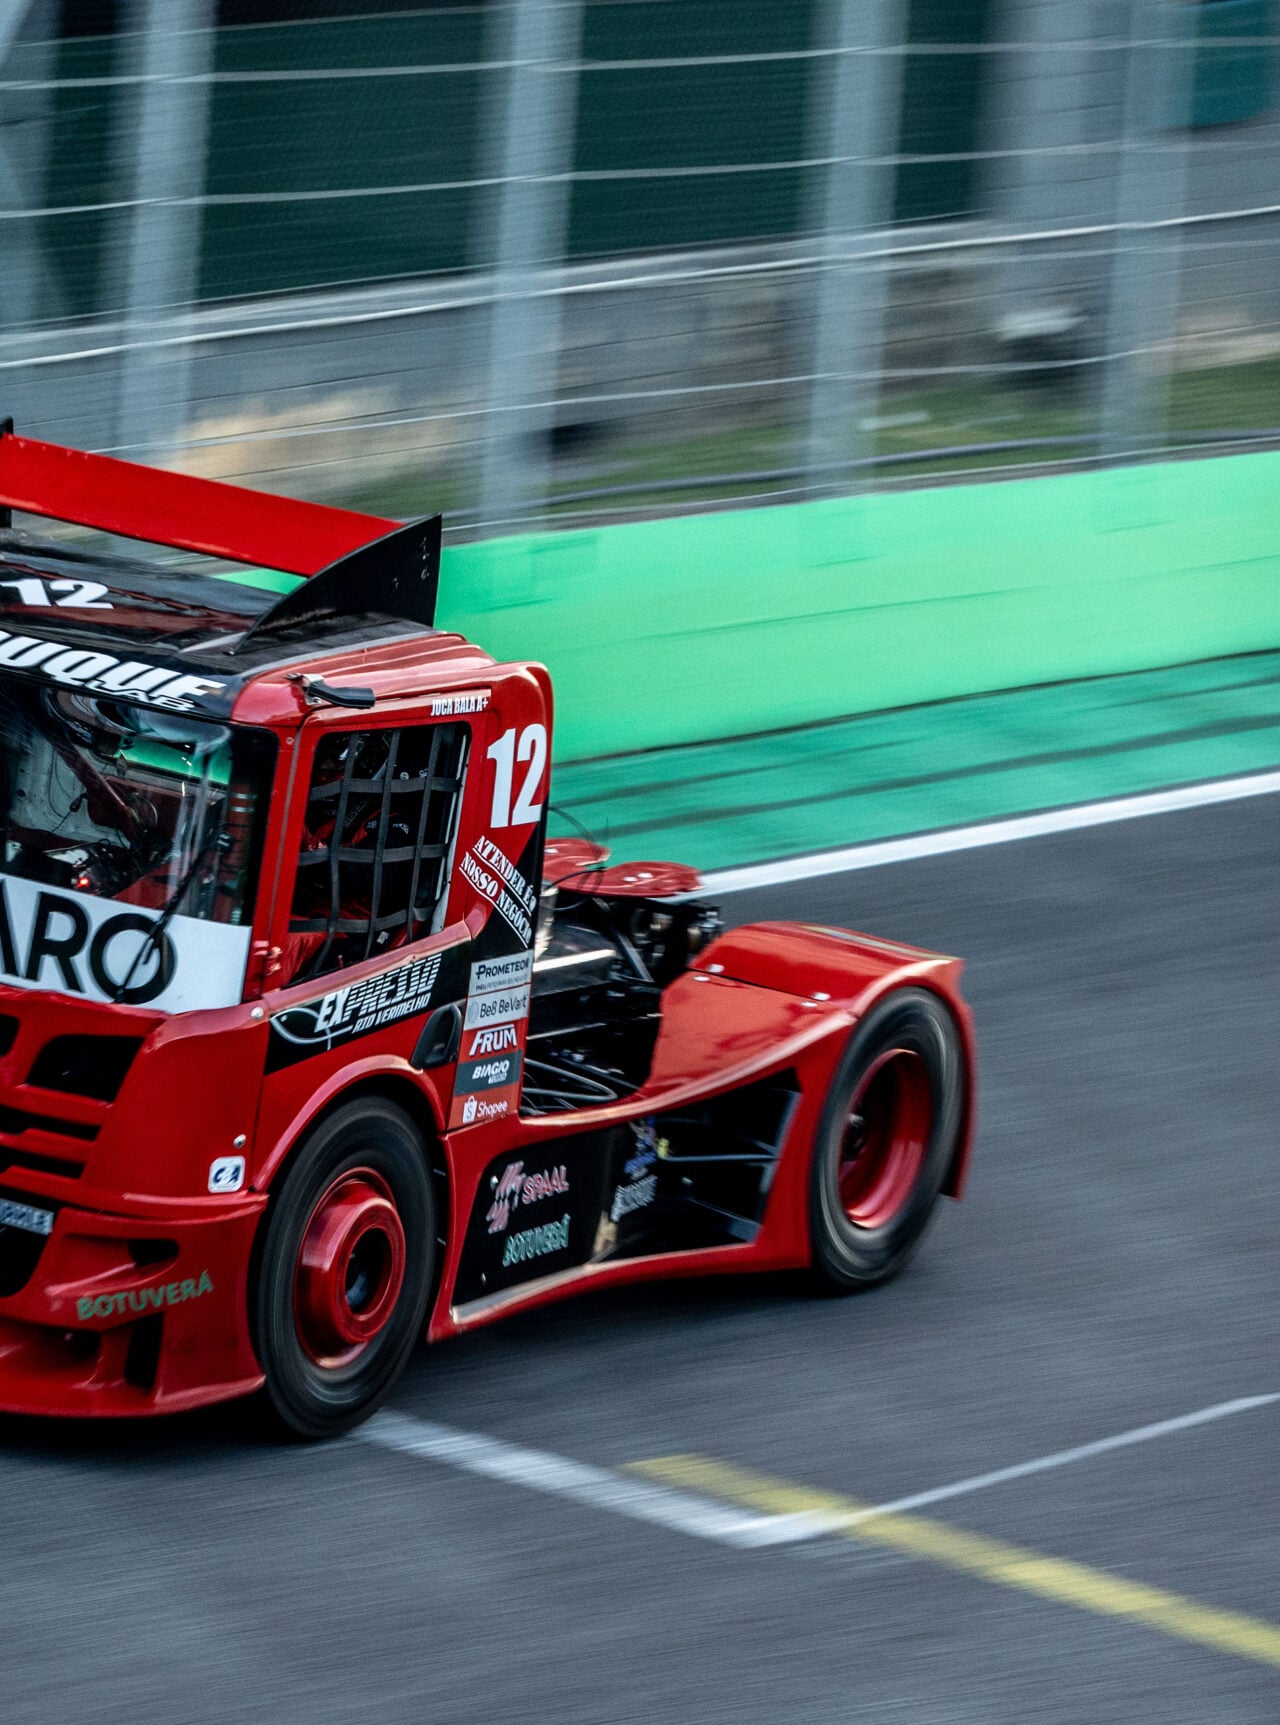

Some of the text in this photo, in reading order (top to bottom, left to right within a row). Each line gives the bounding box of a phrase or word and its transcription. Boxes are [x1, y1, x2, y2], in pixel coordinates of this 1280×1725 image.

[0, 578, 114, 609] 12
[430, 698, 453, 716] JUCA
[453, 696, 476, 715] BALA
[486, 723, 547, 828] 12
[473, 834, 526, 896] ATENDER
[460, 851, 499, 897] NOSSO
[496, 888, 532, 944] NEGÓCIO
[475, 957, 530, 980] PROMETEON
[314, 952, 442, 1034] EXPRESSO
[375, 992, 432, 1026] VERMELHO
[480, 1000, 498, 1018] Be8
[469, 1024, 518, 1057] FRUM
[472, 1060, 510, 1080] BIAGIO
[477, 1100, 508, 1118] Shopee
[522, 1165, 570, 1205] SPAAL
[76, 1269, 215, 1321] BOTUVERÁ
